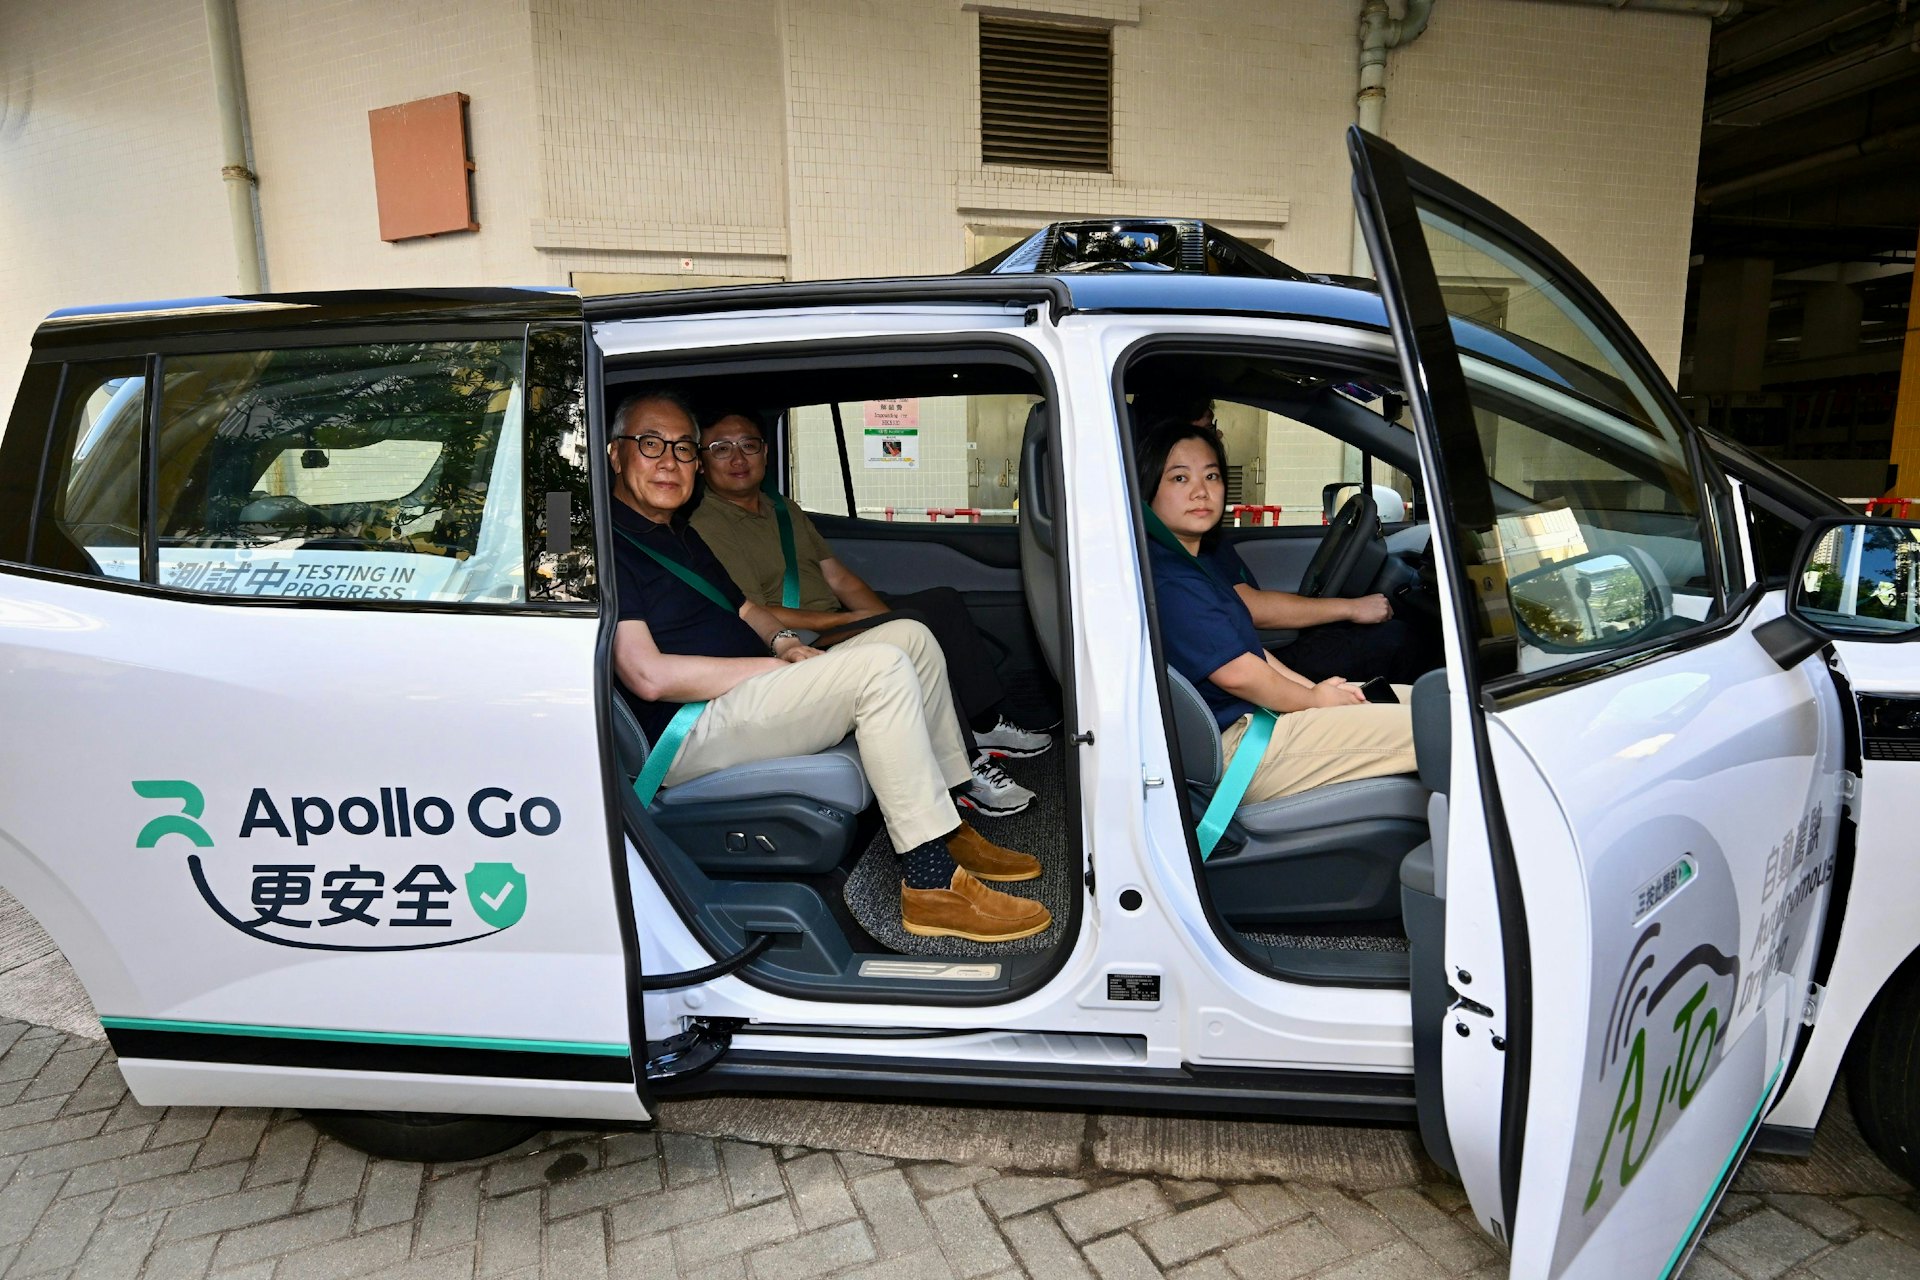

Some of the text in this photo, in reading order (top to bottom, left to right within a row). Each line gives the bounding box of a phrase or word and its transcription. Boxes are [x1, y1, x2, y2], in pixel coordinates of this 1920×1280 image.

[168, 561, 291, 596] 測試中
[281, 583, 408, 600] PROGRESS
[297, 564, 416, 583] TESTING IN
[239, 787, 562, 846] Apollo Go
[1761, 801, 1822, 904] 自動駕駛
[245, 864, 458, 928] 更安全
[1750, 854, 1834, 961] Autonomous
